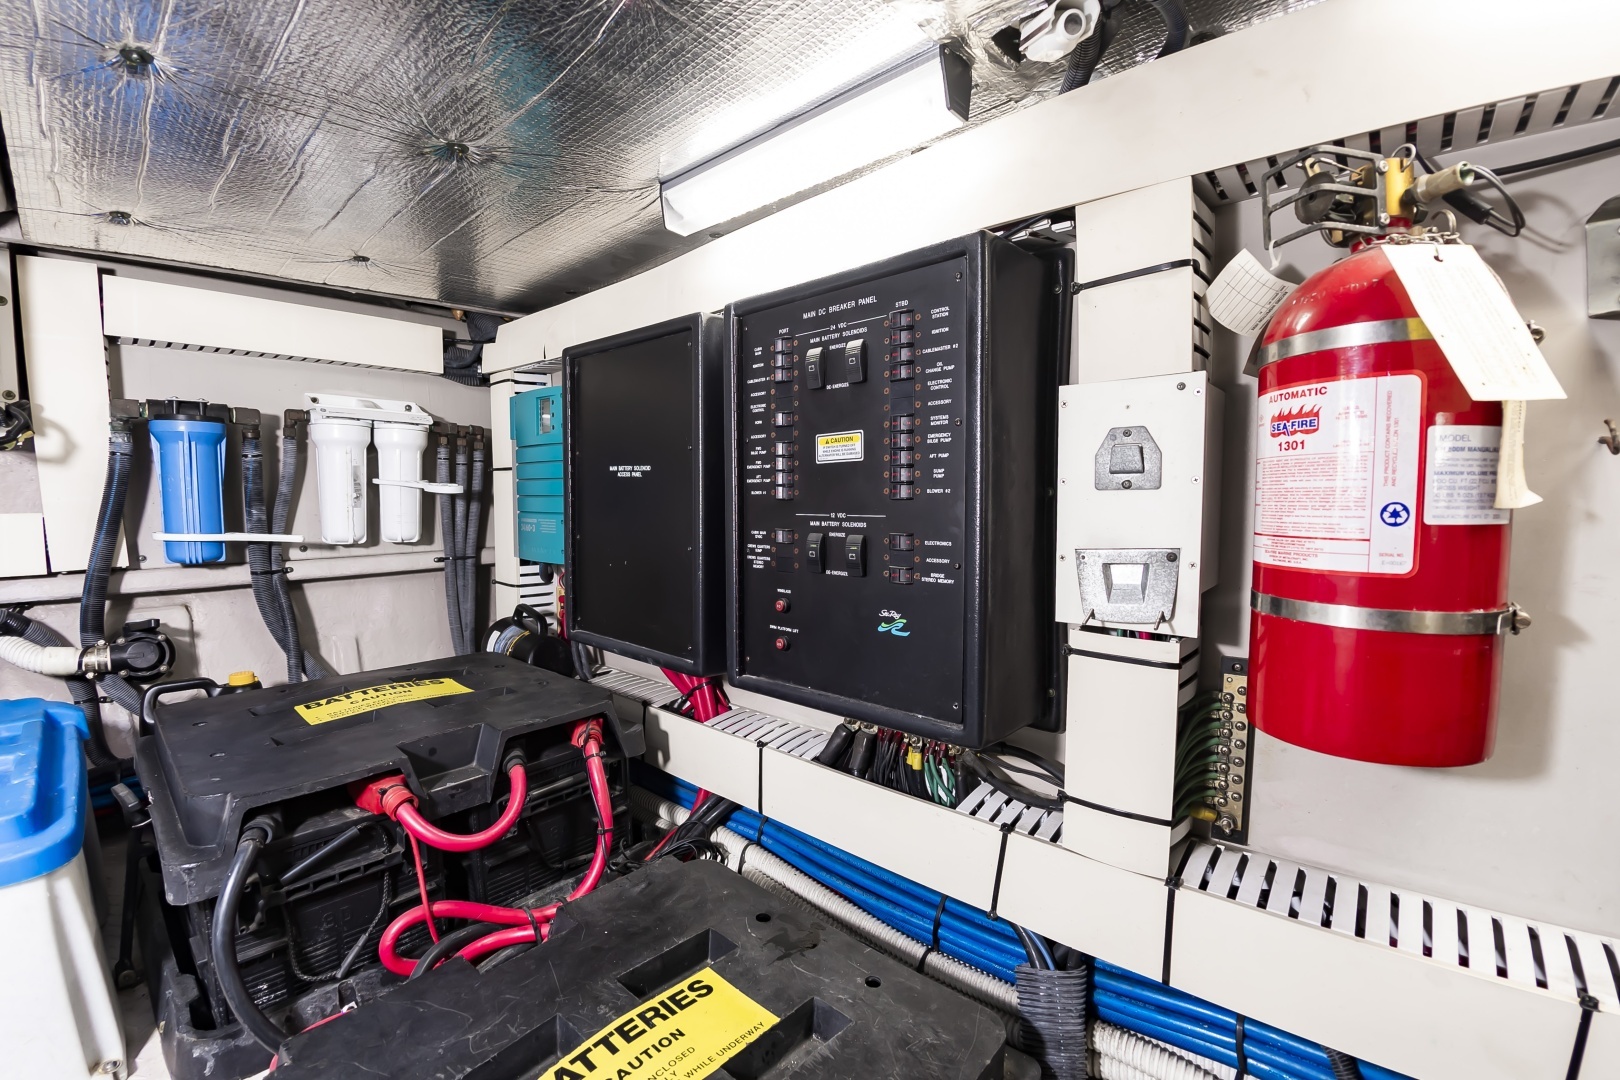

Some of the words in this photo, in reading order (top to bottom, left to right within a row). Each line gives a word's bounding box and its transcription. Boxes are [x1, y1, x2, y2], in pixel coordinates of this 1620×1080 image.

[803, 310, 816, 319] MAIN
[829, 301, 855, 313] BREAKER
[858, 296, 877, 306] PANEL
[822, 332, 840, 341] BATTERY
[842, 327, 868, 337] SOLENOIDS
[922, 345, 951, 354] CABLEMASTER
[1269, 386, 1328, 404] AUTOMATIC
[1278, 440, 1305, 452] 1301
[304, 679, 445, 710] BATTERIES
[350, 690, 412, 704] CAUTION
[553, 979, 714, 1080] ATTERIES
[605, 1028, 686, 1080] AUTION
[684, 1056, 716, 1078] WHILE
[716, 1021, 764, 1056] UNDERWAY
[648, 1046, 695, 1080] NCLOSED
